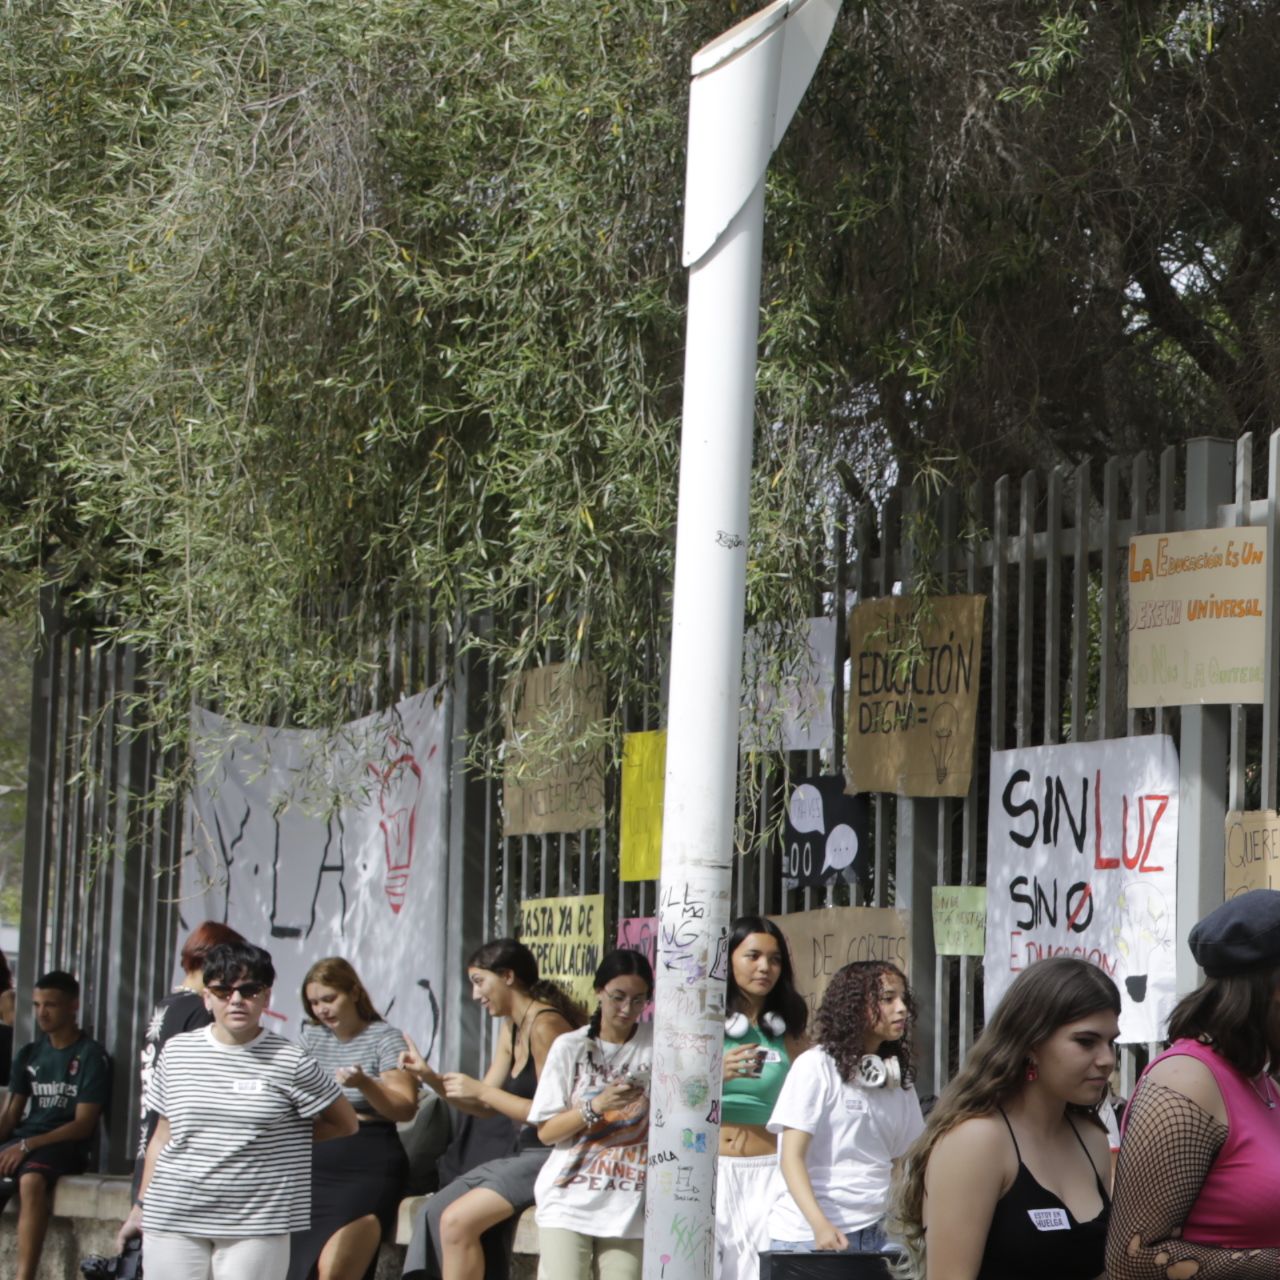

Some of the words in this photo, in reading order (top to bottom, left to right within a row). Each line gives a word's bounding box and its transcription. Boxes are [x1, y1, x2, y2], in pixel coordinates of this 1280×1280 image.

[1002, 769, 1089, 854] SIN
[1094, 768, 1170, 873] LUZ
[520, 905, 553, 938] BASTA
[559, 905, 572, 936] YA
[578, 904, 594, 937] DE
[528, 940, 599, 977] PECULACIÓN
[812, 932, 834, 979] DE
[567, 1174, 644, 1192] PEACE
[1036, 1218, 1064, 1228] HUELGA
